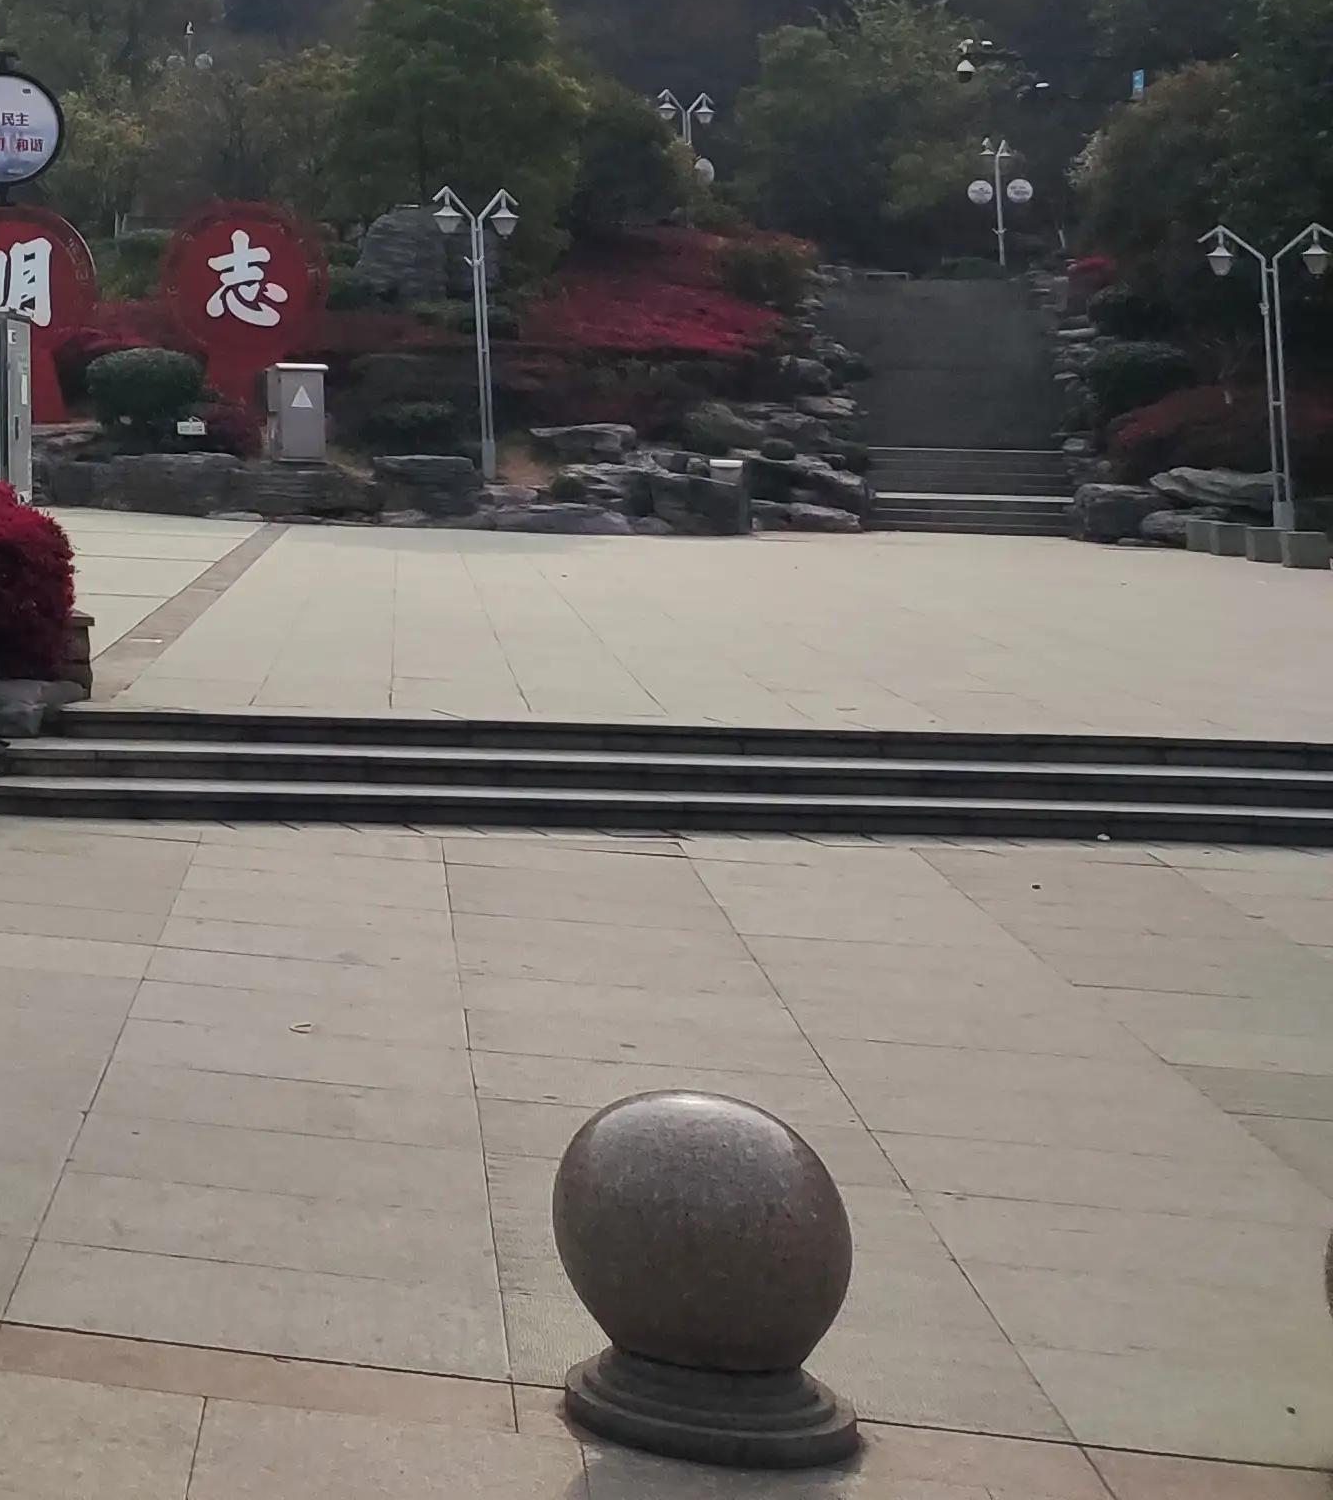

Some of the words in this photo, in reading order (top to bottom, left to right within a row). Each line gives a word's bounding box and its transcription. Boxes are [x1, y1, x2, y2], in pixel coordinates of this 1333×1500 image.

[1, 112, 30, 127] 民主
[16, 138, 44, 152] 和谐
[206, 228, 289, 327] 志
